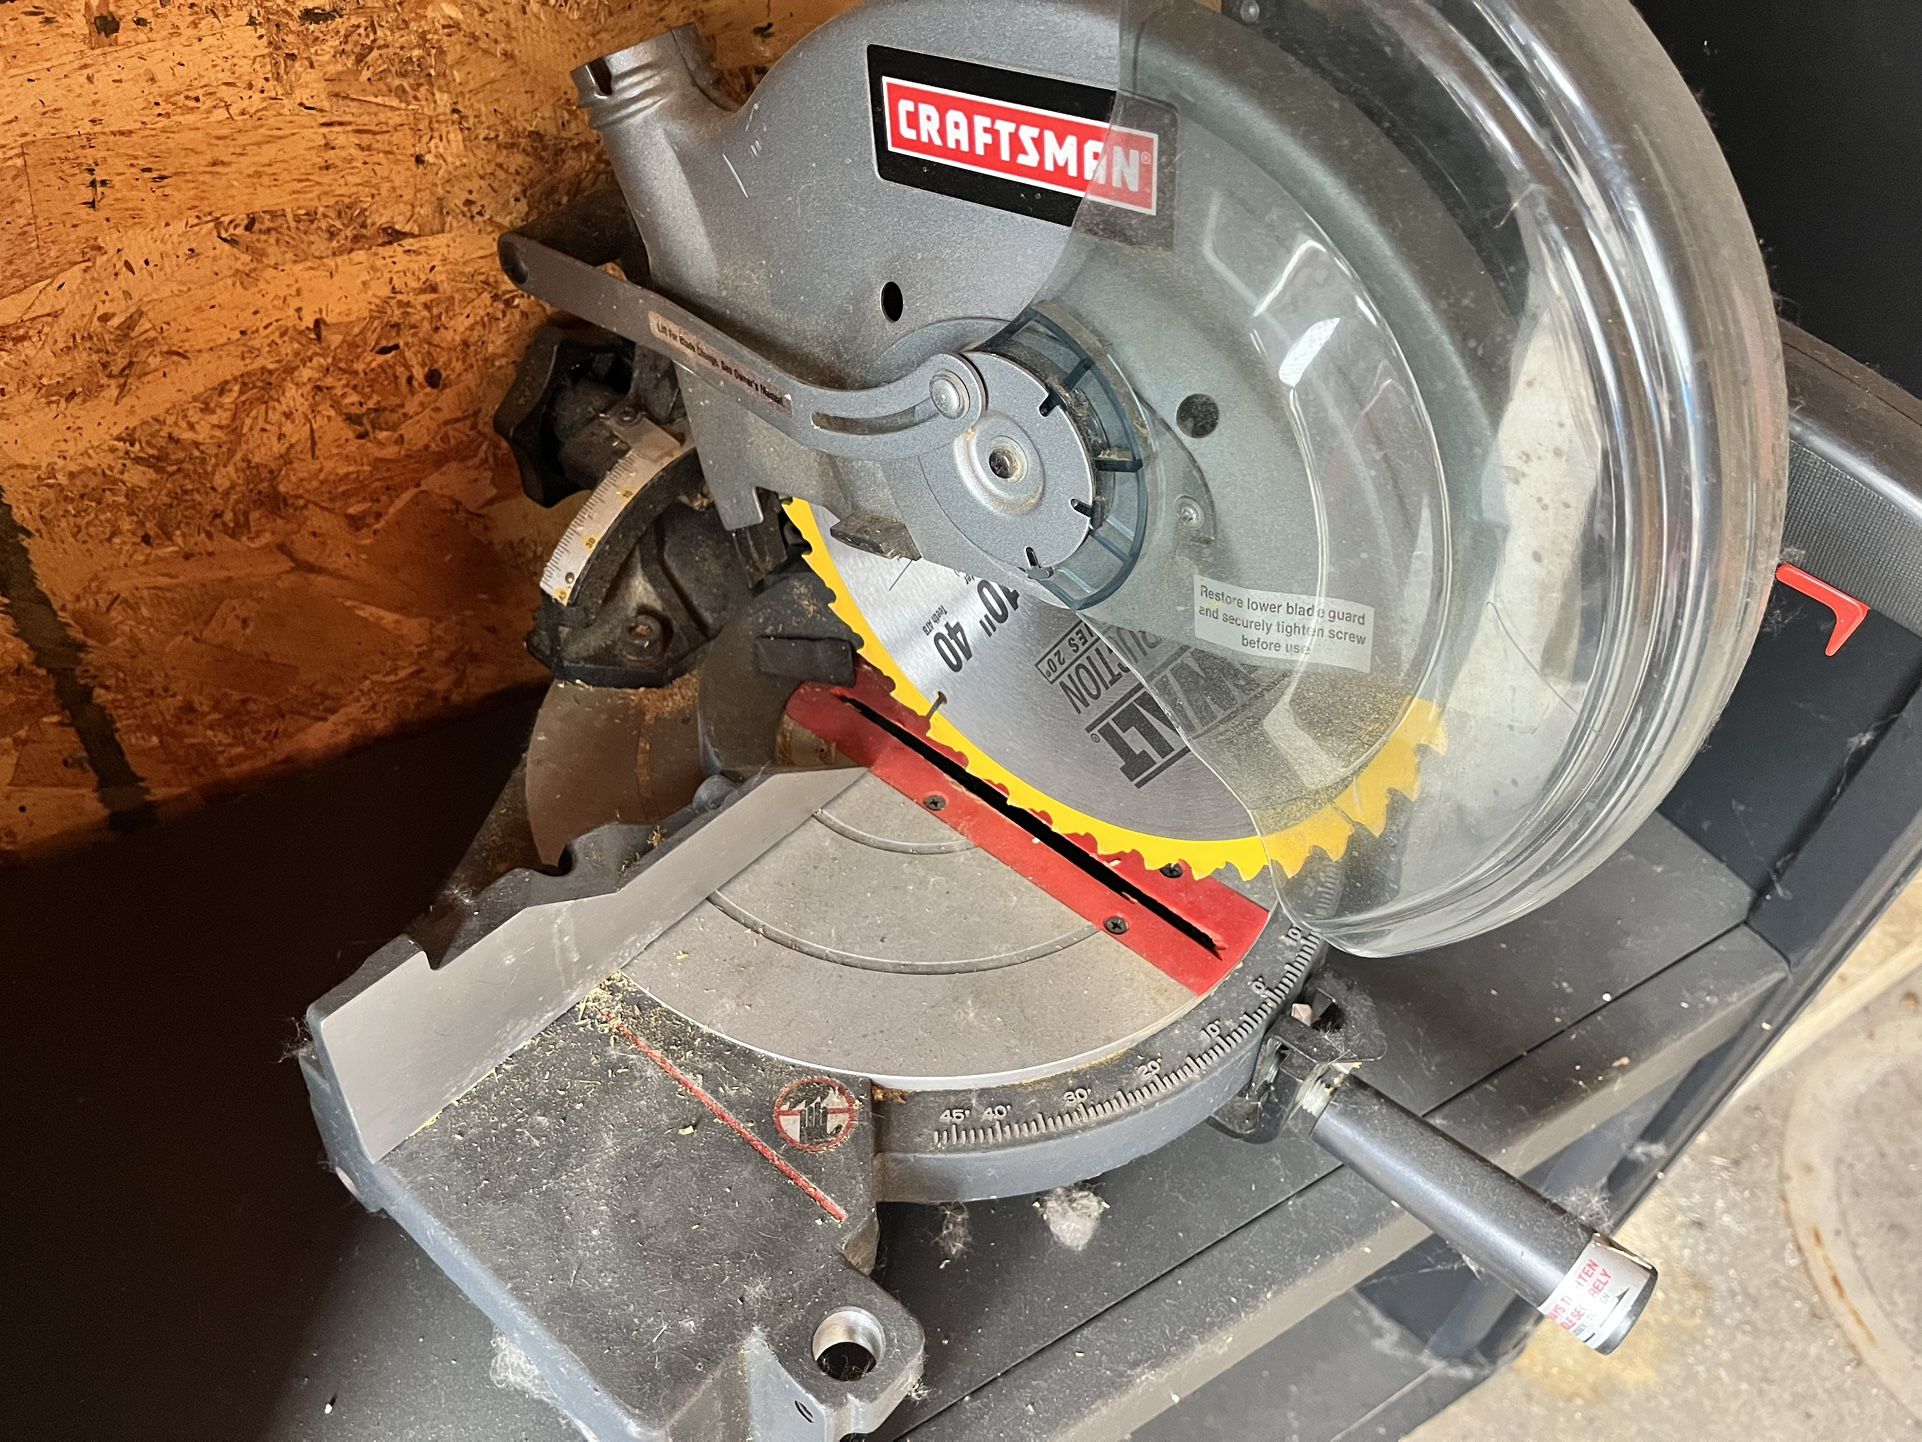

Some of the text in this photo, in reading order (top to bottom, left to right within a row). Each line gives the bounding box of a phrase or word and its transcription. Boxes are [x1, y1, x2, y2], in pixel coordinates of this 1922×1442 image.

[897, 98, 1140, 192] CRAFTSMAN
[585, 537, 596, 549] 30
[930, 604, 948, 625] Teeth
[1199, 605, 1367, 646] and securely tighten screw
[1200, 584, 1366, 626] Restore lower blade guard
[933, 621, 973, 673] 40
[1241, 635, 1281, 652] before
